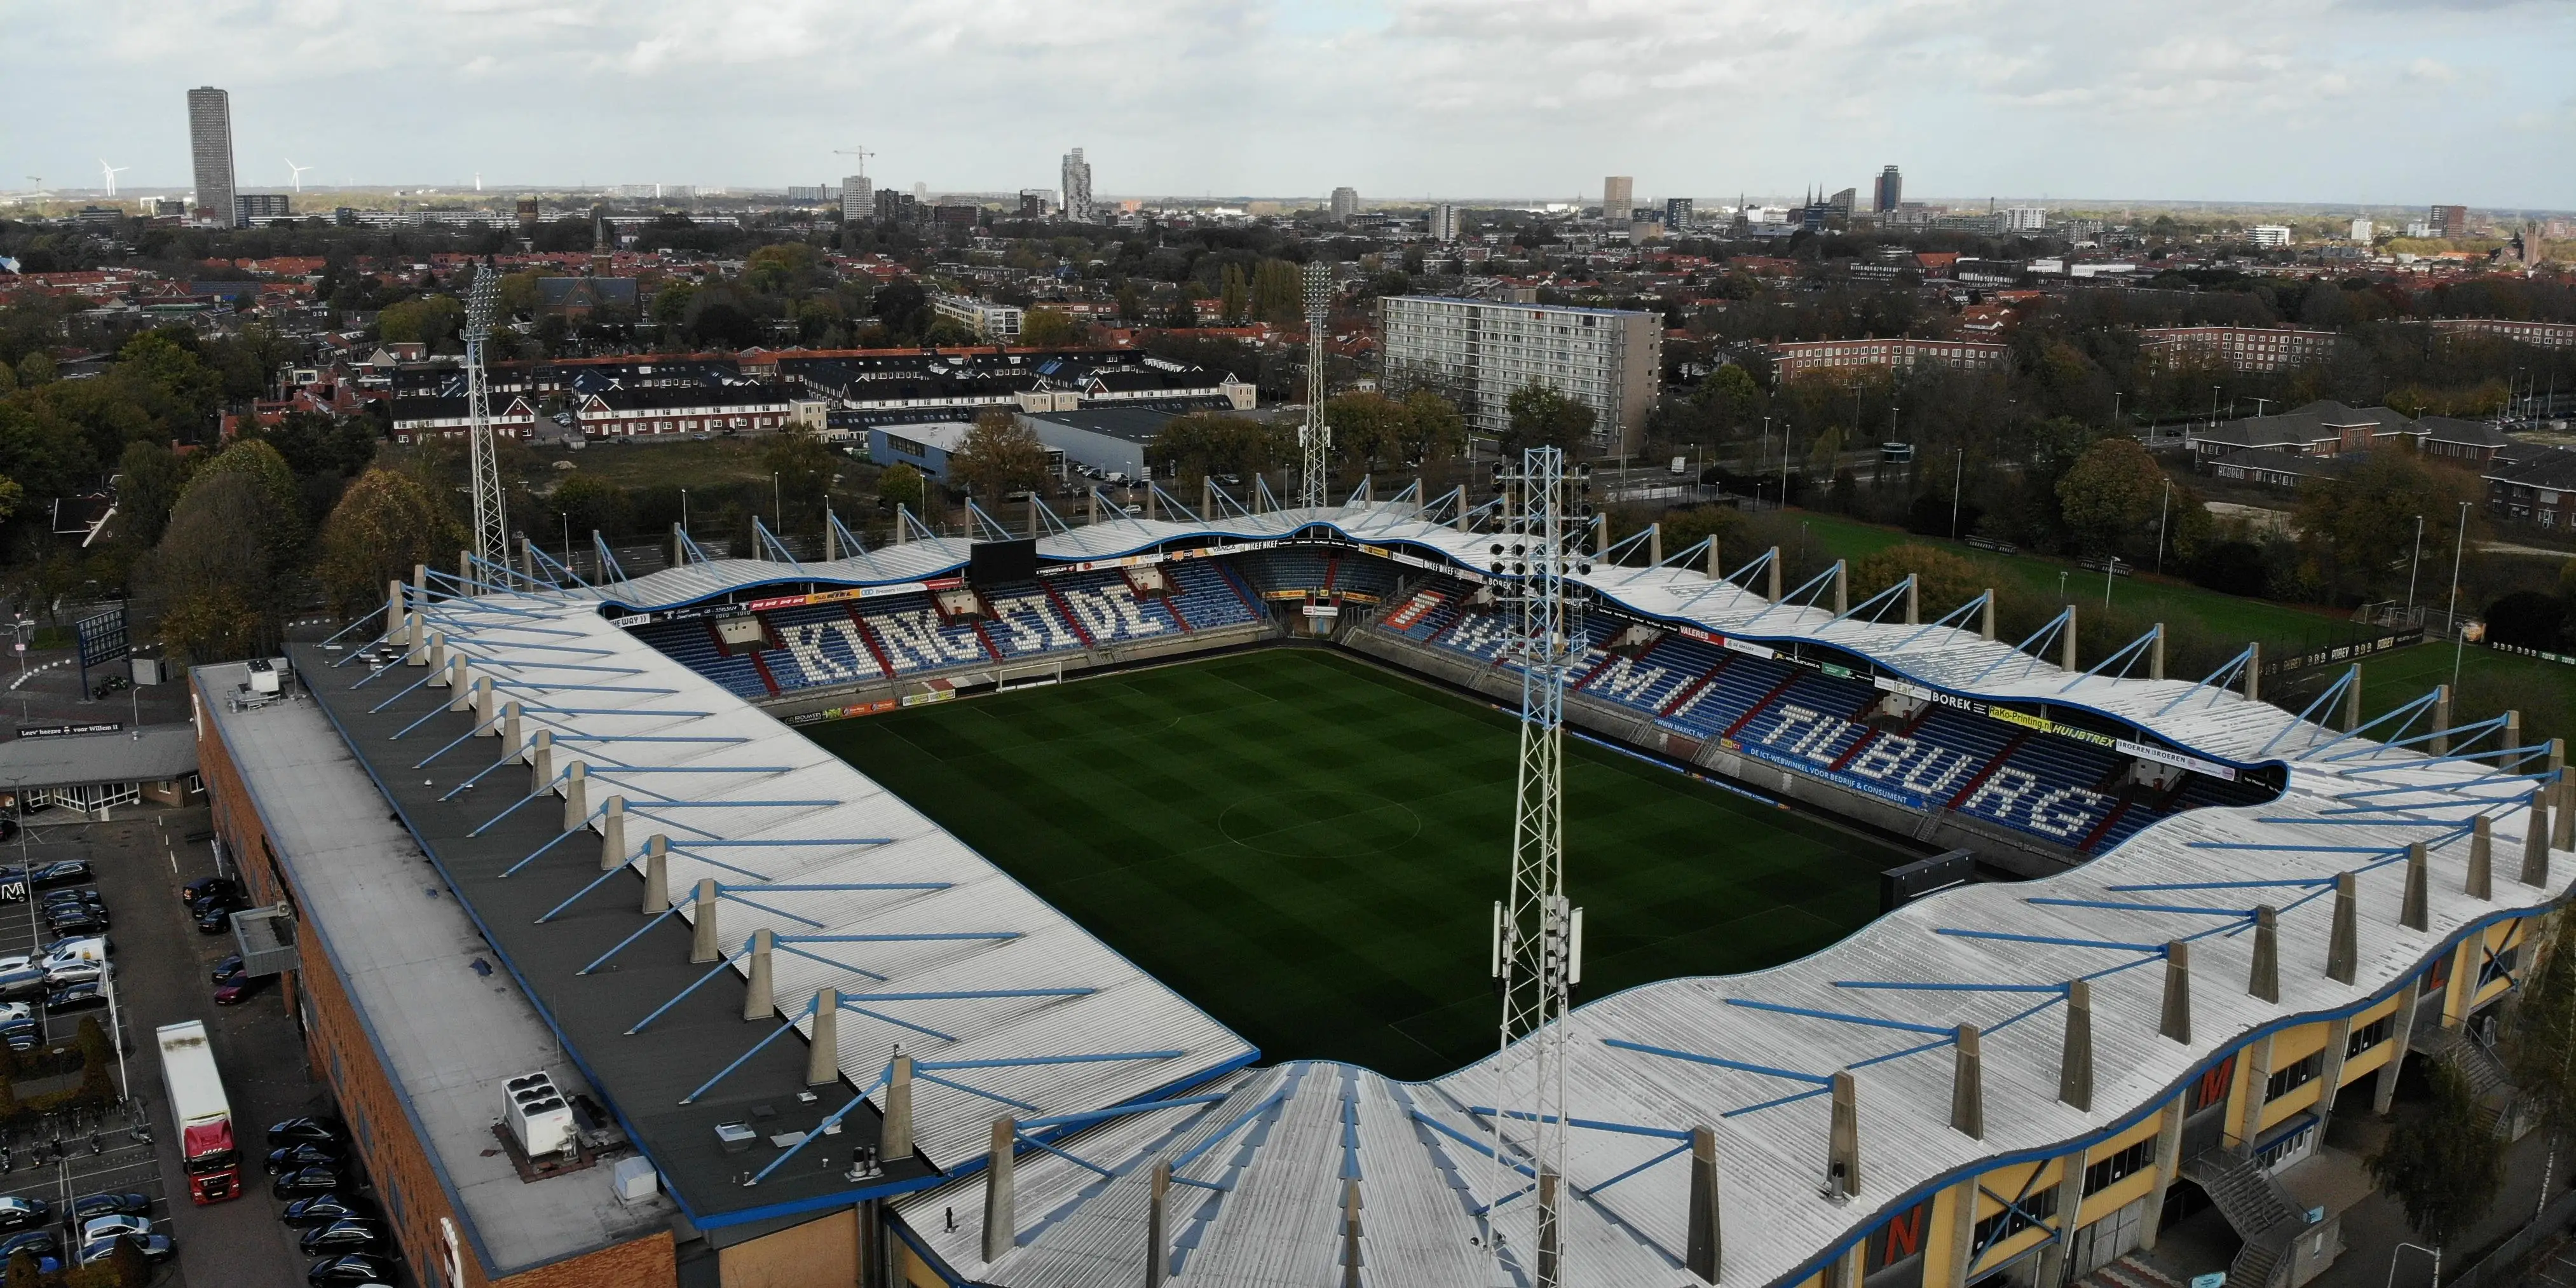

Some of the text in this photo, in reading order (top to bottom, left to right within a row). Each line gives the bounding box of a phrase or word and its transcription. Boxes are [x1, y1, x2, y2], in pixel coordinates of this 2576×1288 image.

[622, 617, 639, 626] WAY
[993, 584, 1163, 651] SIDE
[1680, 626, 1708, 640] VALERES
[779, 607, 980, 683] KING
[1932, 692, 1972, 711] BOREK
[1989, 706, 2052, 731] RaKo-Printing.nl
[2053, 724, 2116, 748] HUIJBTREX
[1750, 748, 1759, 756] DE
[1760, 751, 1808, 772] ICT-WEBWINKEL
[1810, 767, 1829, 779] VOOR
[1830, 774, 1855, 788] BEDRIJF
[1863, 784, 1907, 804] CONSUMENT
[1762, 704, 2102, 837] TILBURG
[1884, 1203, 1922, 1266] N
